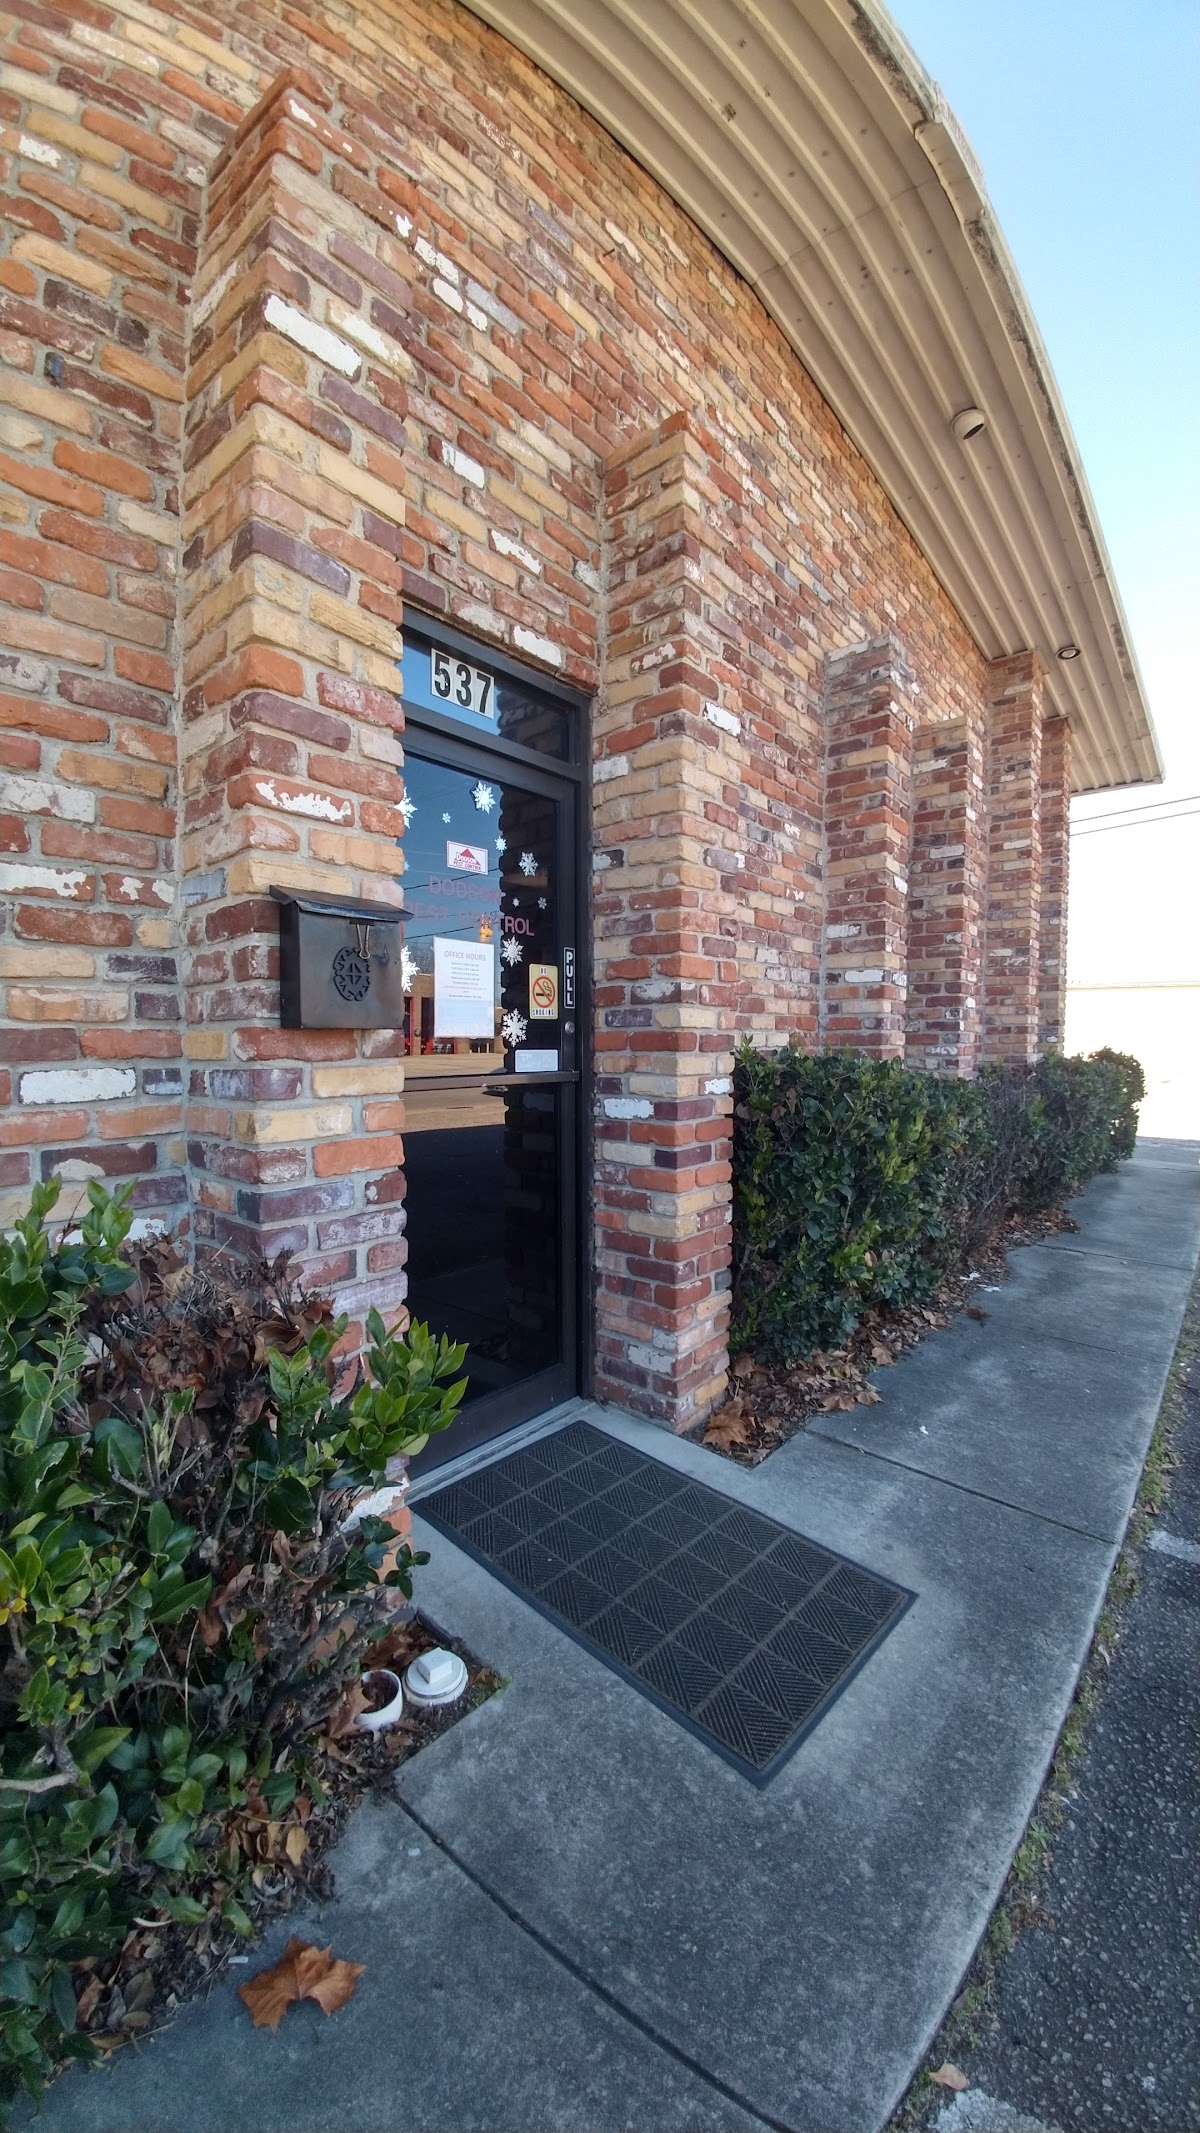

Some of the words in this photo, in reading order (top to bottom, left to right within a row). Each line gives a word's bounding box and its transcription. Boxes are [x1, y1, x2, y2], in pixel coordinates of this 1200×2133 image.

[434, 652, 492, 714] 537
[465, 862, 482, 871] CONTROL
[428, 875, 502, 905] DODSON
[404, 901, 448, 920] PEST
[458, 910, 535, 936] CONTROL
[444, 950, 464, 959] OFFICE
[465, 953, 486, 961] HOURS
[565, 951, 574, 1005] PULL
